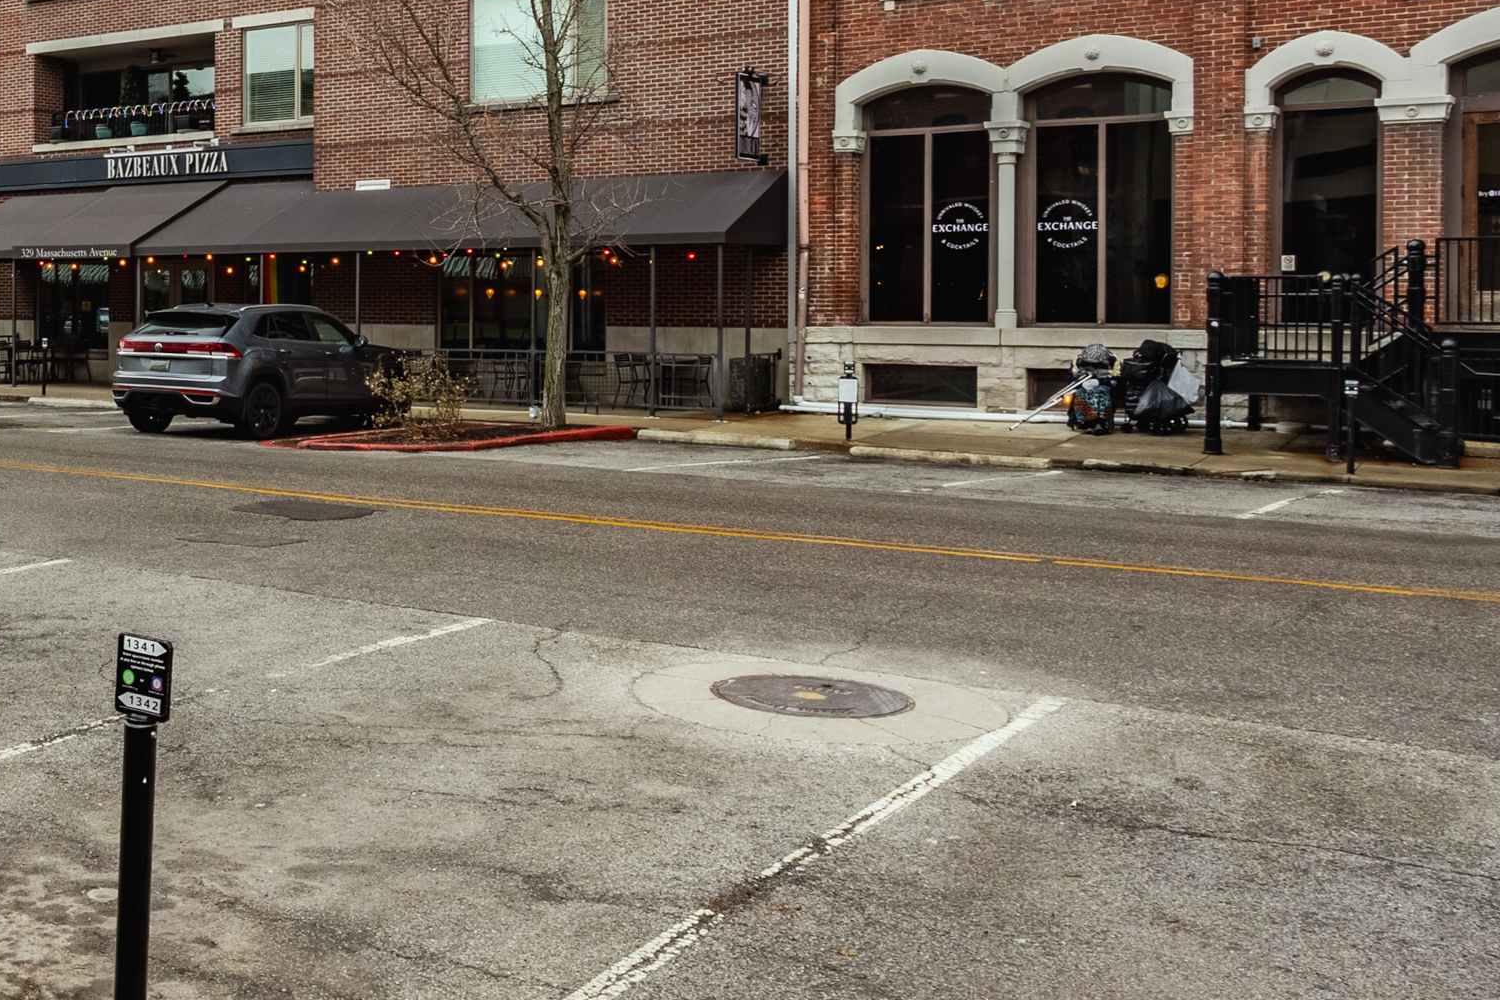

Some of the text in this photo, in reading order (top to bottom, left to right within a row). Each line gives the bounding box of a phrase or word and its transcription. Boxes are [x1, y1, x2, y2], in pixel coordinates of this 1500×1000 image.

[107, 151, 229, 179] BAZBEAUX PIZZA
[932, 223, 989, 233] EXCHANGE
[1037, 221, 1098, 231] EXCHANGE
[1052, 236, 1088, 248] COCKTAILS
[20, 247, 118, 258] 329 Massachusetts Avenue
[127, 639, 155, 652] 1341
[129, 696, 158, 710] 1342
